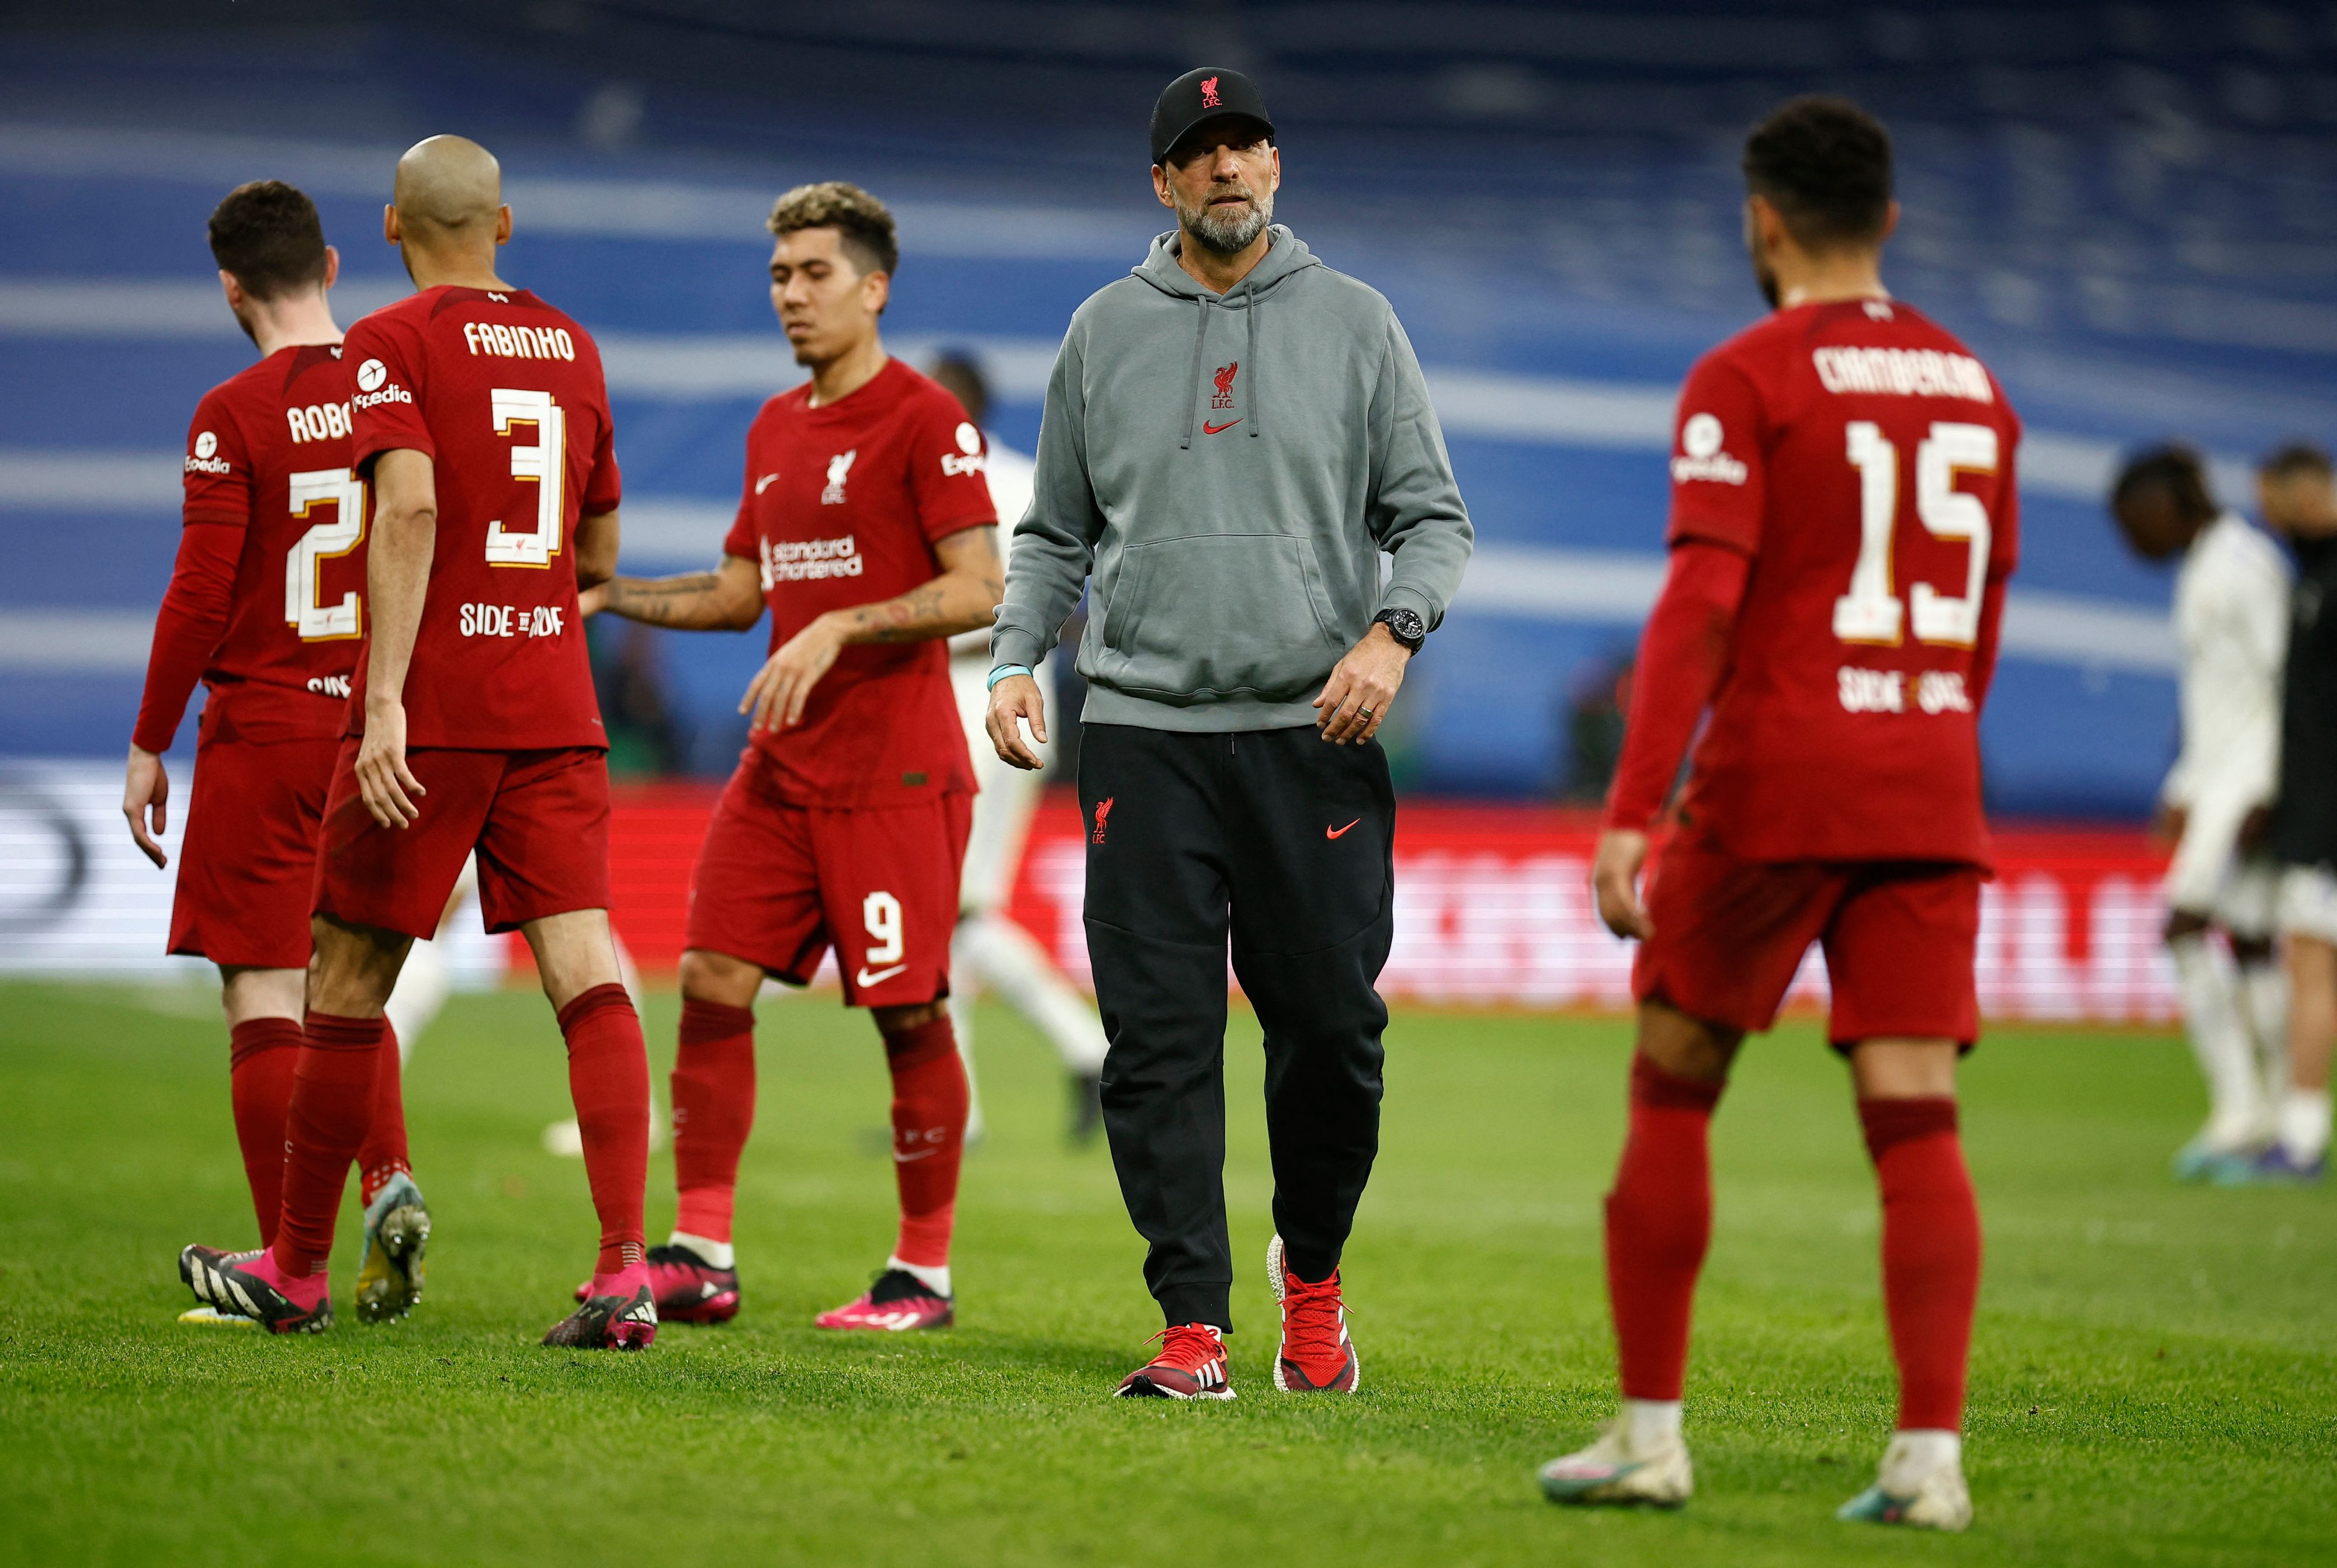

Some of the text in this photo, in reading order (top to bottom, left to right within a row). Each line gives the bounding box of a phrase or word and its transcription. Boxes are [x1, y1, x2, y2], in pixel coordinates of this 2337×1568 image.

[463, 322, 576, 362] FABINHO
[1211, 399, 1235, 409] L.F.C.
[485, 388, 566, 570] 3
[1832, 421, 1998, 649] 15
[460, 602, 515, 637] SIDE
[862, 890, 904, 965] 9
